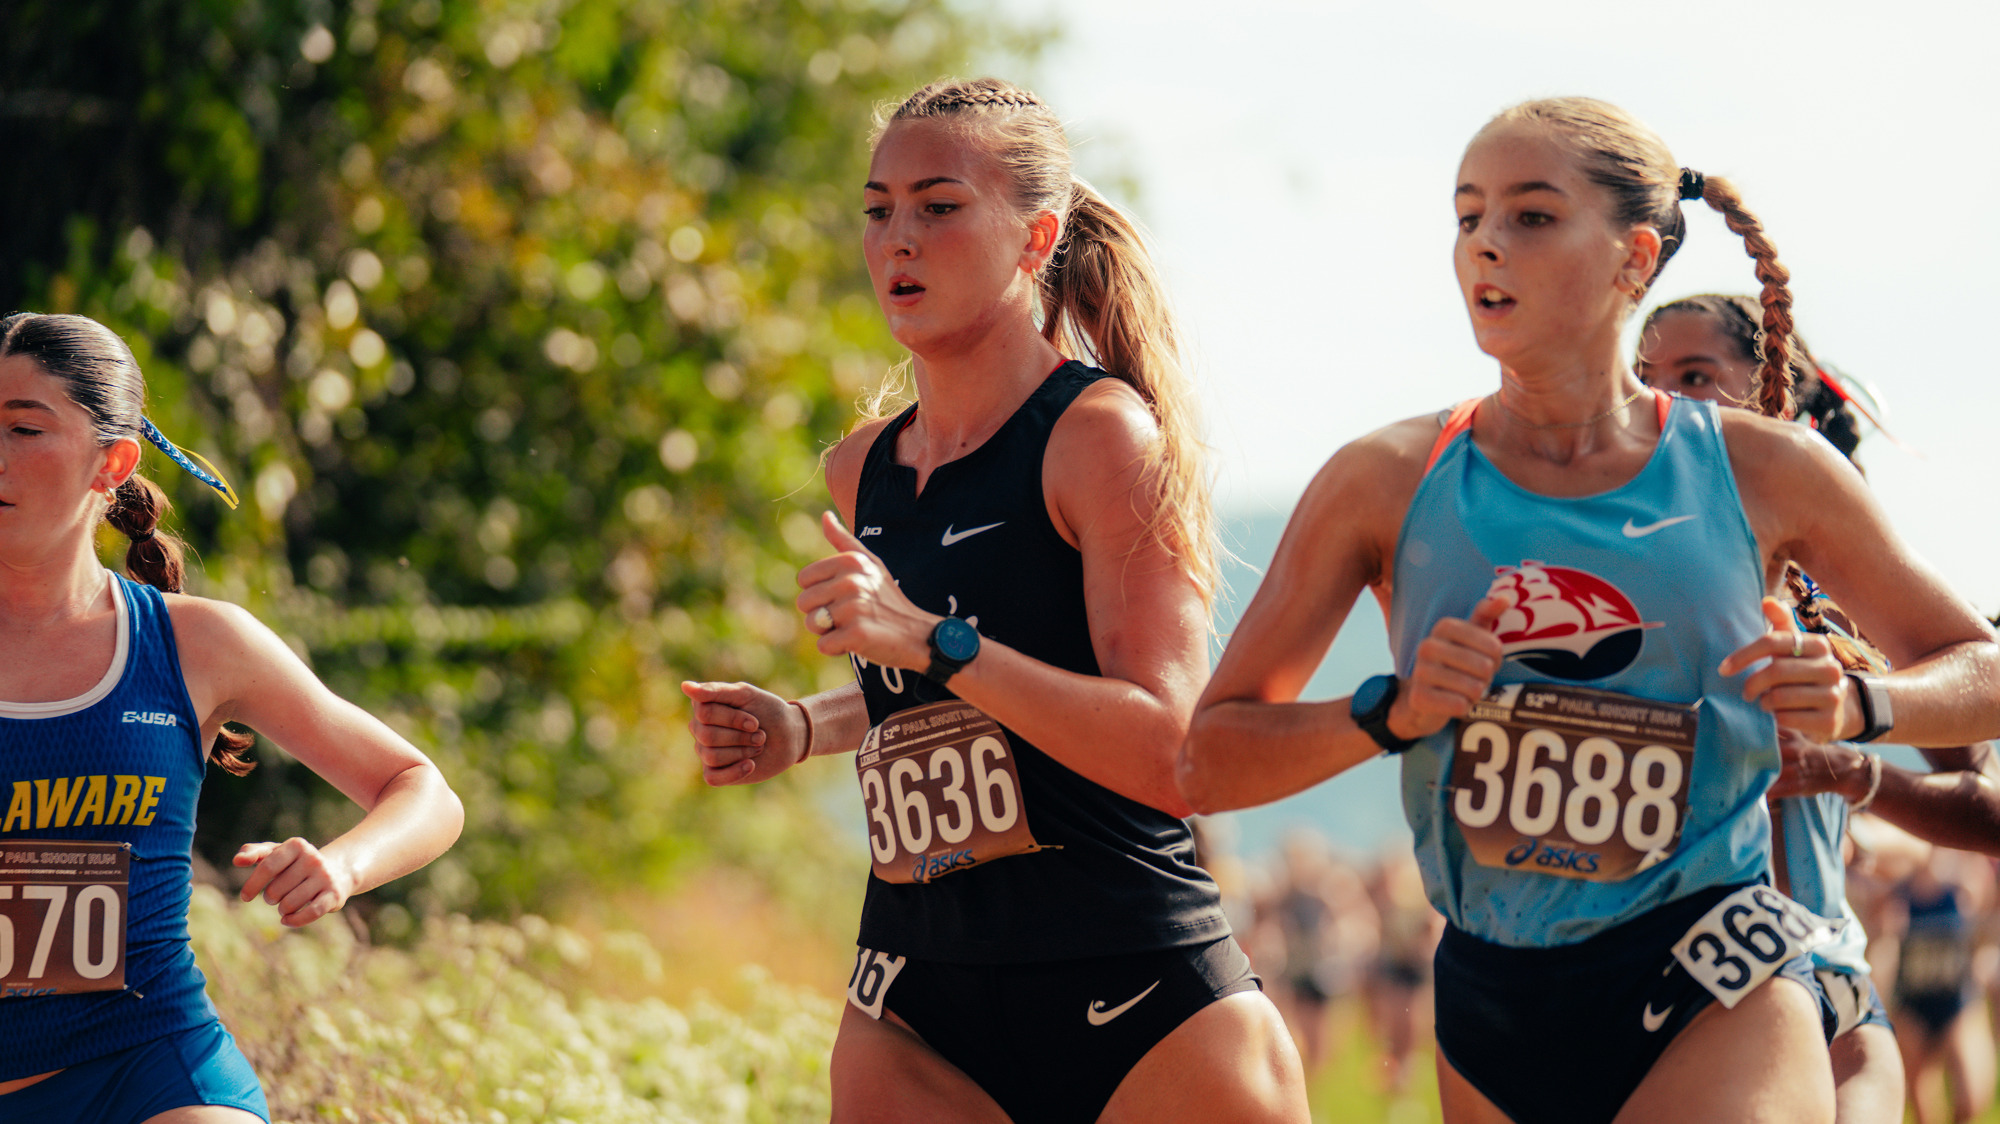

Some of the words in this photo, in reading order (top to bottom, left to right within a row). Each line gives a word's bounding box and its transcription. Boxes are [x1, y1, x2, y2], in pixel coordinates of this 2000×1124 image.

[901, 719, 930, 736] PAUL
[929, 710, 962, 728] SHORT
[1649, 708, 1683, 728] RUN
[862, 736, 1018, 864] 3636
[1454, 721, 1683, 852] 3688
[0, 775, 167, 832] AWARE
[5, 852, 39, 864] PAUL
[40, 852, 87, 864] SHORT
[87, 853, 117, 865] RUN
[928, 849, 976, 878] asics
[1535, 843, 1599, 873] asics
